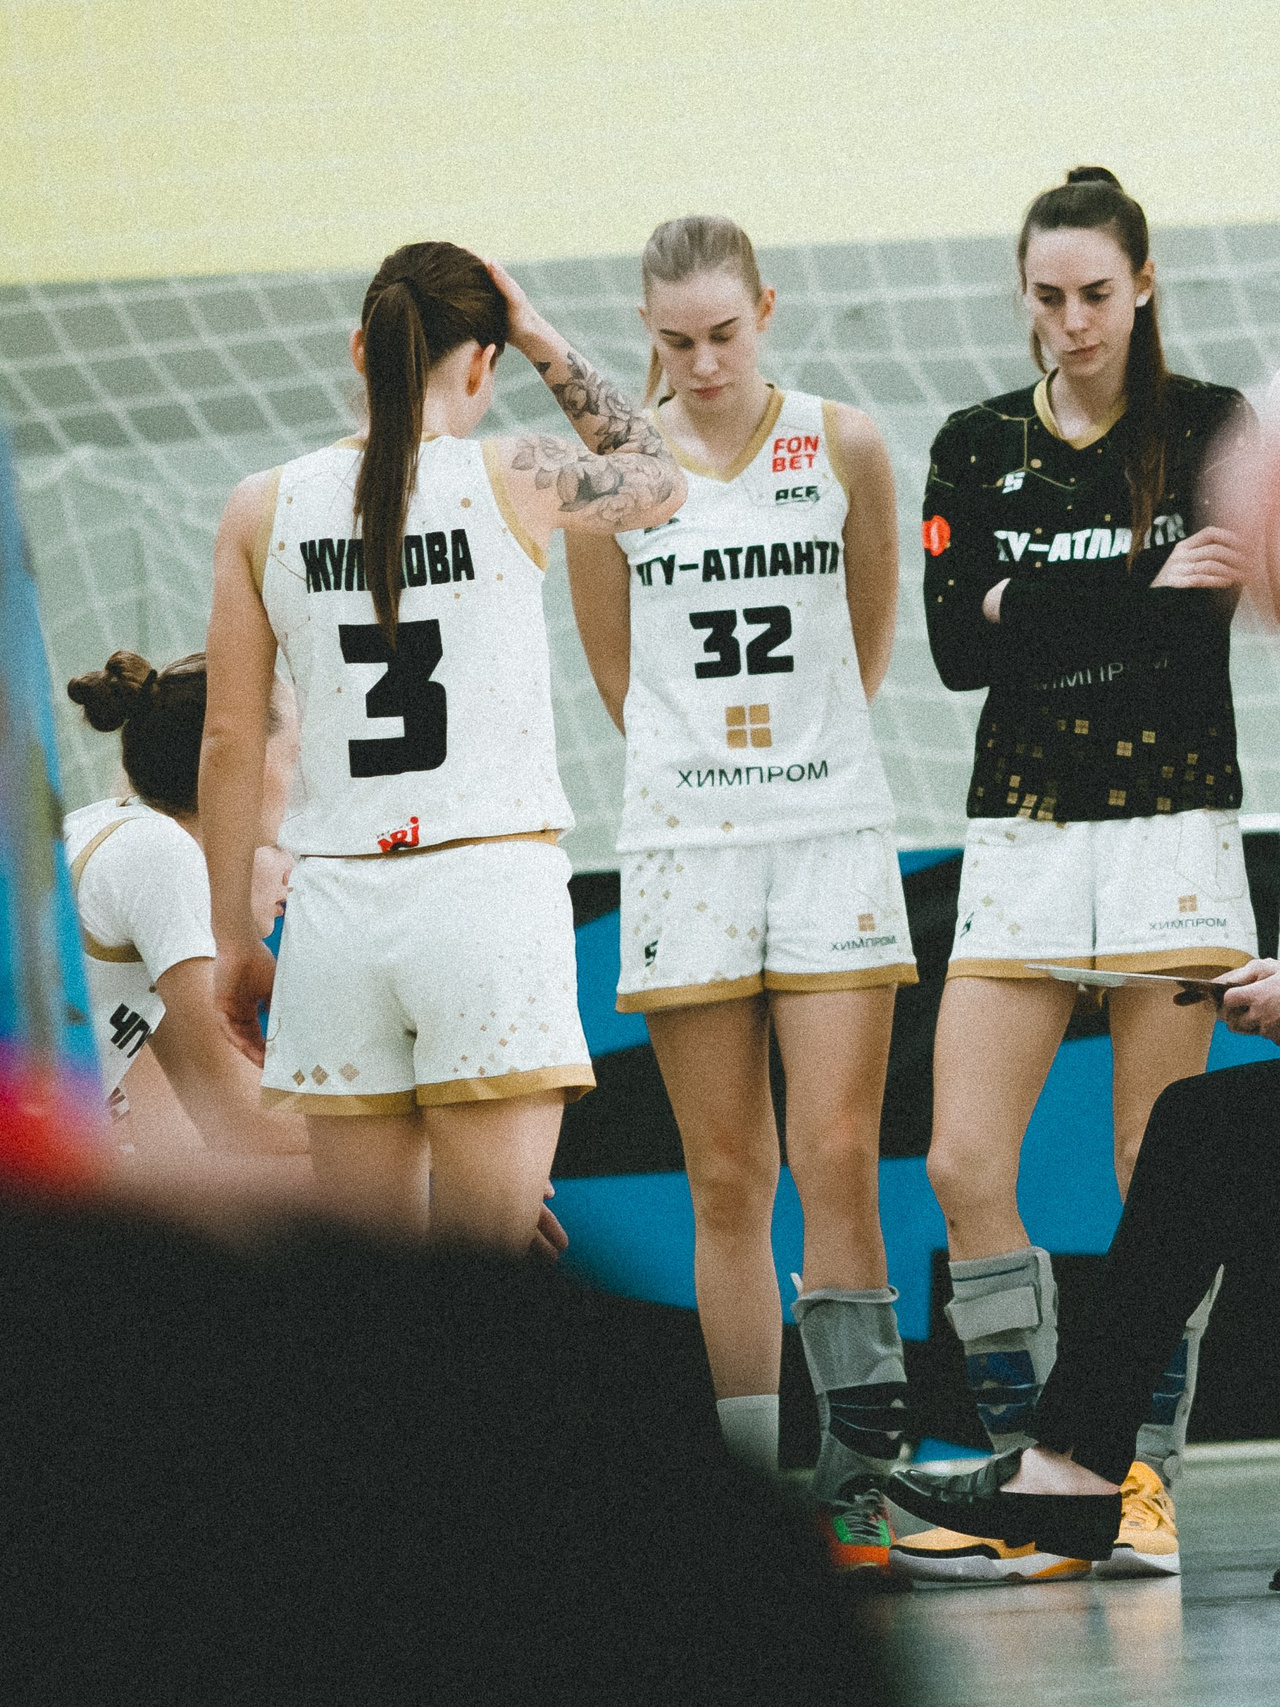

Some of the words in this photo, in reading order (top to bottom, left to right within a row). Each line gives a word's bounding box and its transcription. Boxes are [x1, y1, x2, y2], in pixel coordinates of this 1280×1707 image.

[773, 436, 819, 455] FON
[772, 454, 815, 473] BET
[299, 528, 475, 594] ЖУЛОВА
[689, 605, 794, 680] 32
[338, 619, 447, 778] 3
[676, 760, 829, 788] ХИМПРОМ
[1149, 918, 1227, 931] ХИМПРОМ
